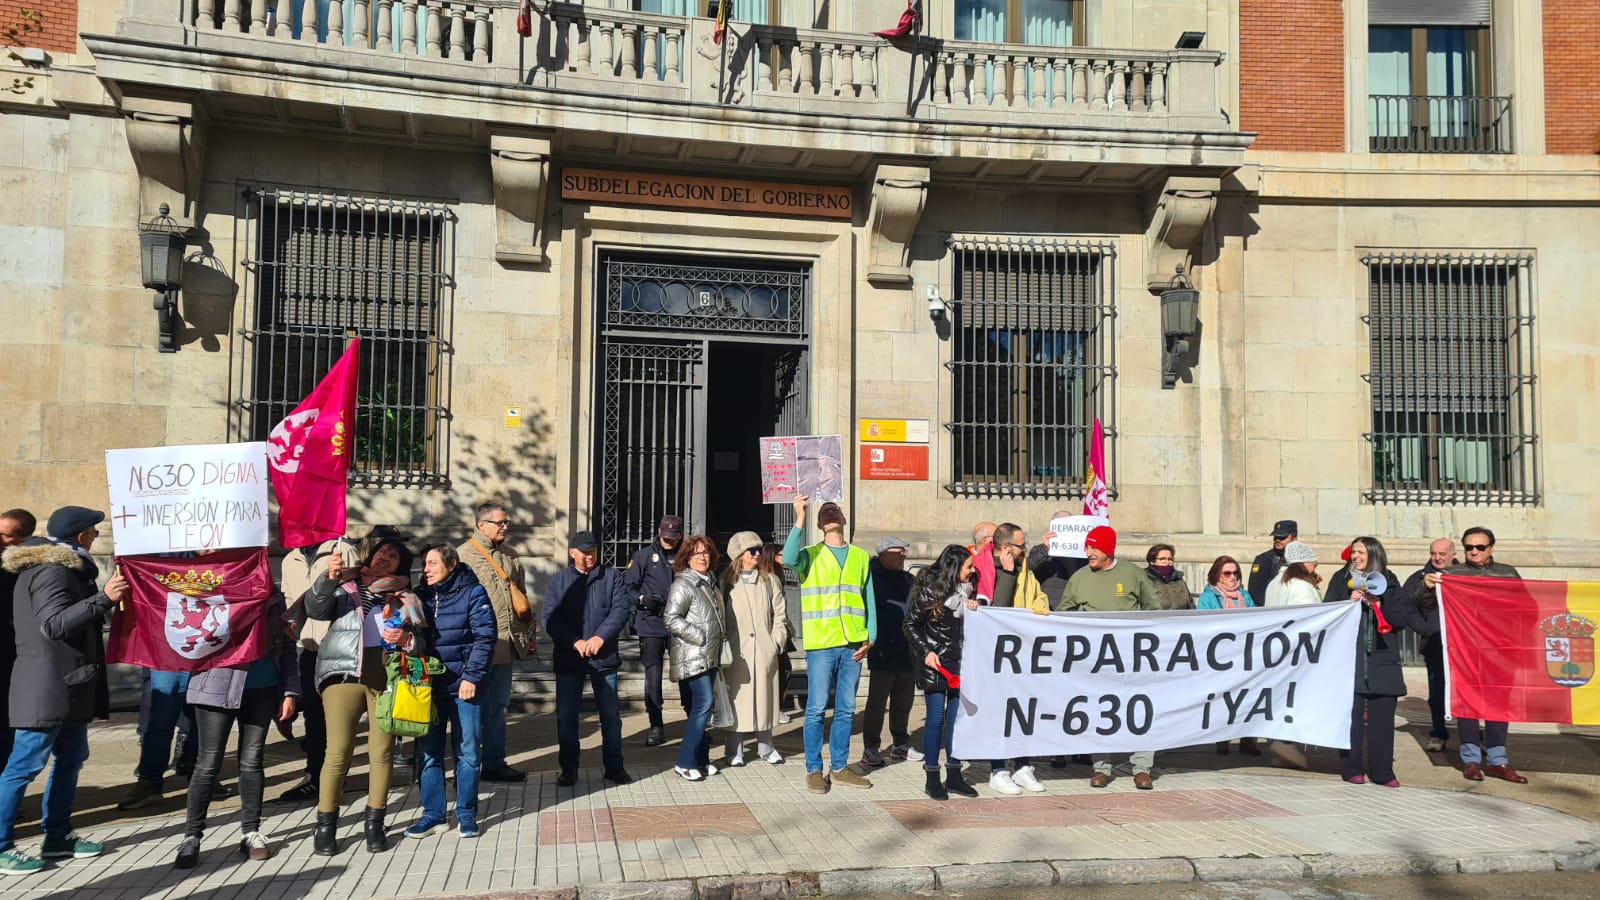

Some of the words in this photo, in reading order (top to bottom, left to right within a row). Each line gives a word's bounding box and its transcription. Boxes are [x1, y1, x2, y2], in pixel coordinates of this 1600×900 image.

[564, 175, 715, 200] SUBDELEGACION
[720, 187, 757, 204] DEL
[762, 190, 850, 210] GOBIERNO
[700, 293, 710, 305] 6
[202, 459, 258, 486] DIGNA
[225, 500, 262, 523] PARA
[1051, 542, 1079, 550] N-630
[993, 620, 1327, 674] REPARACIÓN
[1003, 693, 1154, 738] N-630
[1201, 681, 1295, 730] ¡YA!
